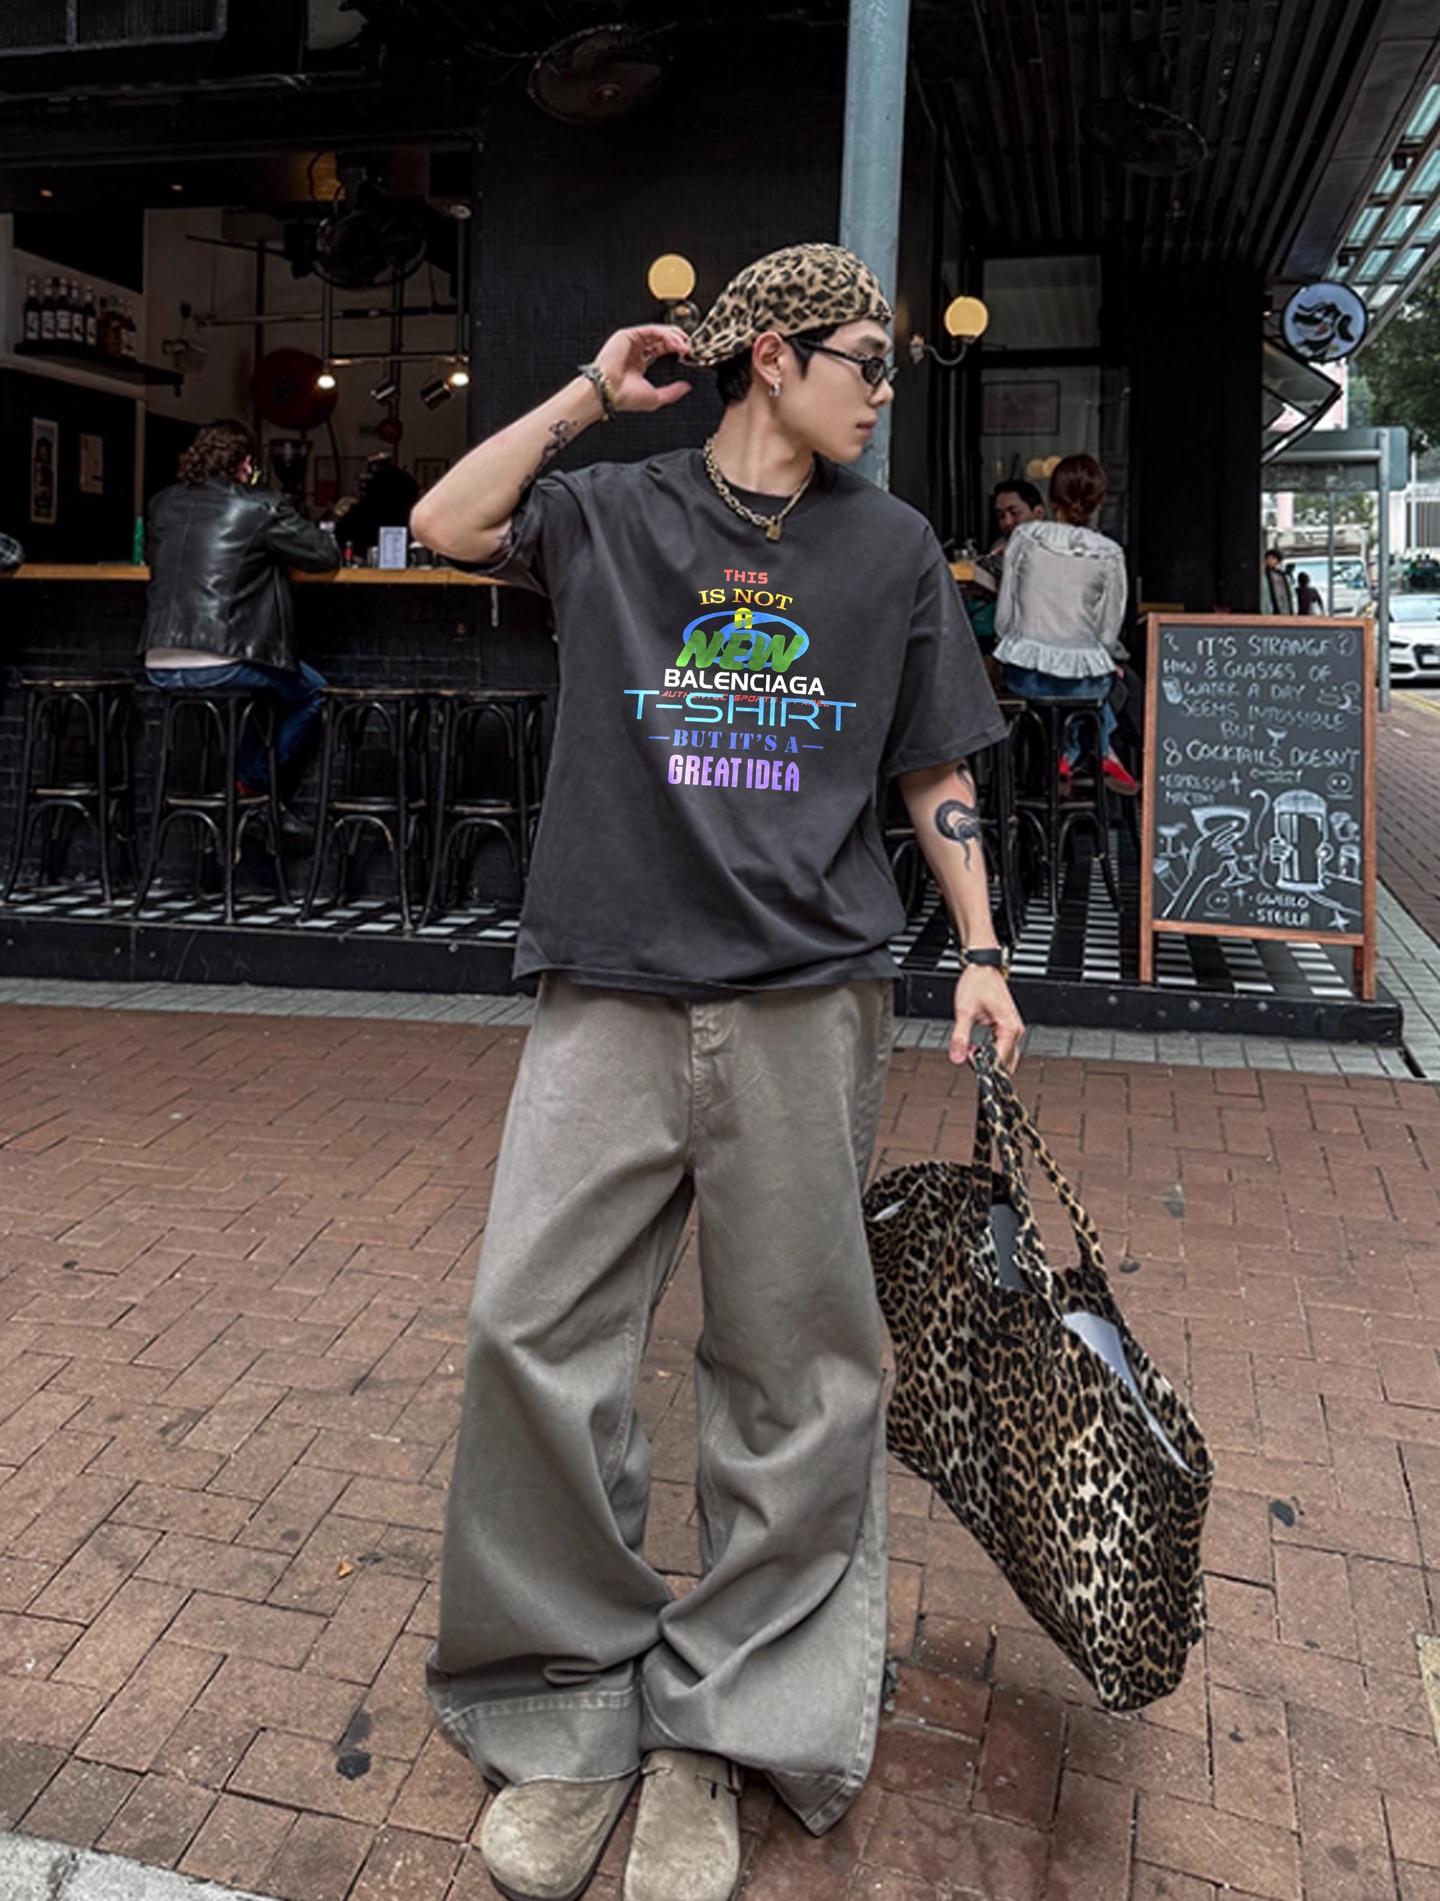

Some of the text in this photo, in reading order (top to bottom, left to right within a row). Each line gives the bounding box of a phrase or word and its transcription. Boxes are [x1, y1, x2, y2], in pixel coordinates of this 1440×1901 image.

[724, 569, 768, 585] THIS
[698, 588, 793, 611] IS NOT
[734, 607, 753, 629] A
[676, 629, 805, 673] NEW
[1197, 637, 1236, 657] IT'S
[1248, 635, 1331, 657] STRANGE
[664, 668, 825, 696] BALENCIAGA
[1204, 659, 1217, 678] 8
[1223, 661, 1296, 680] GLASSES
[1309, 665, 1331, 682] OF
[1184, 681, 1306, 700] WATER A DAY
[623, 689, 857, 732] T-SHIRT
[1182, 699, 1346, 731] SEEMS IMPOSSIBLE
[673, 729, 799, 754] BUT IT'S A
[1221, 721, 1256, 743] BUT
[1163, 737, 1361, 772] 8 COCKTAILS DOESN'T
[668, 754, 800, 792] GREAT IDEA
[1257, 908, 1311, 927] STELLA
